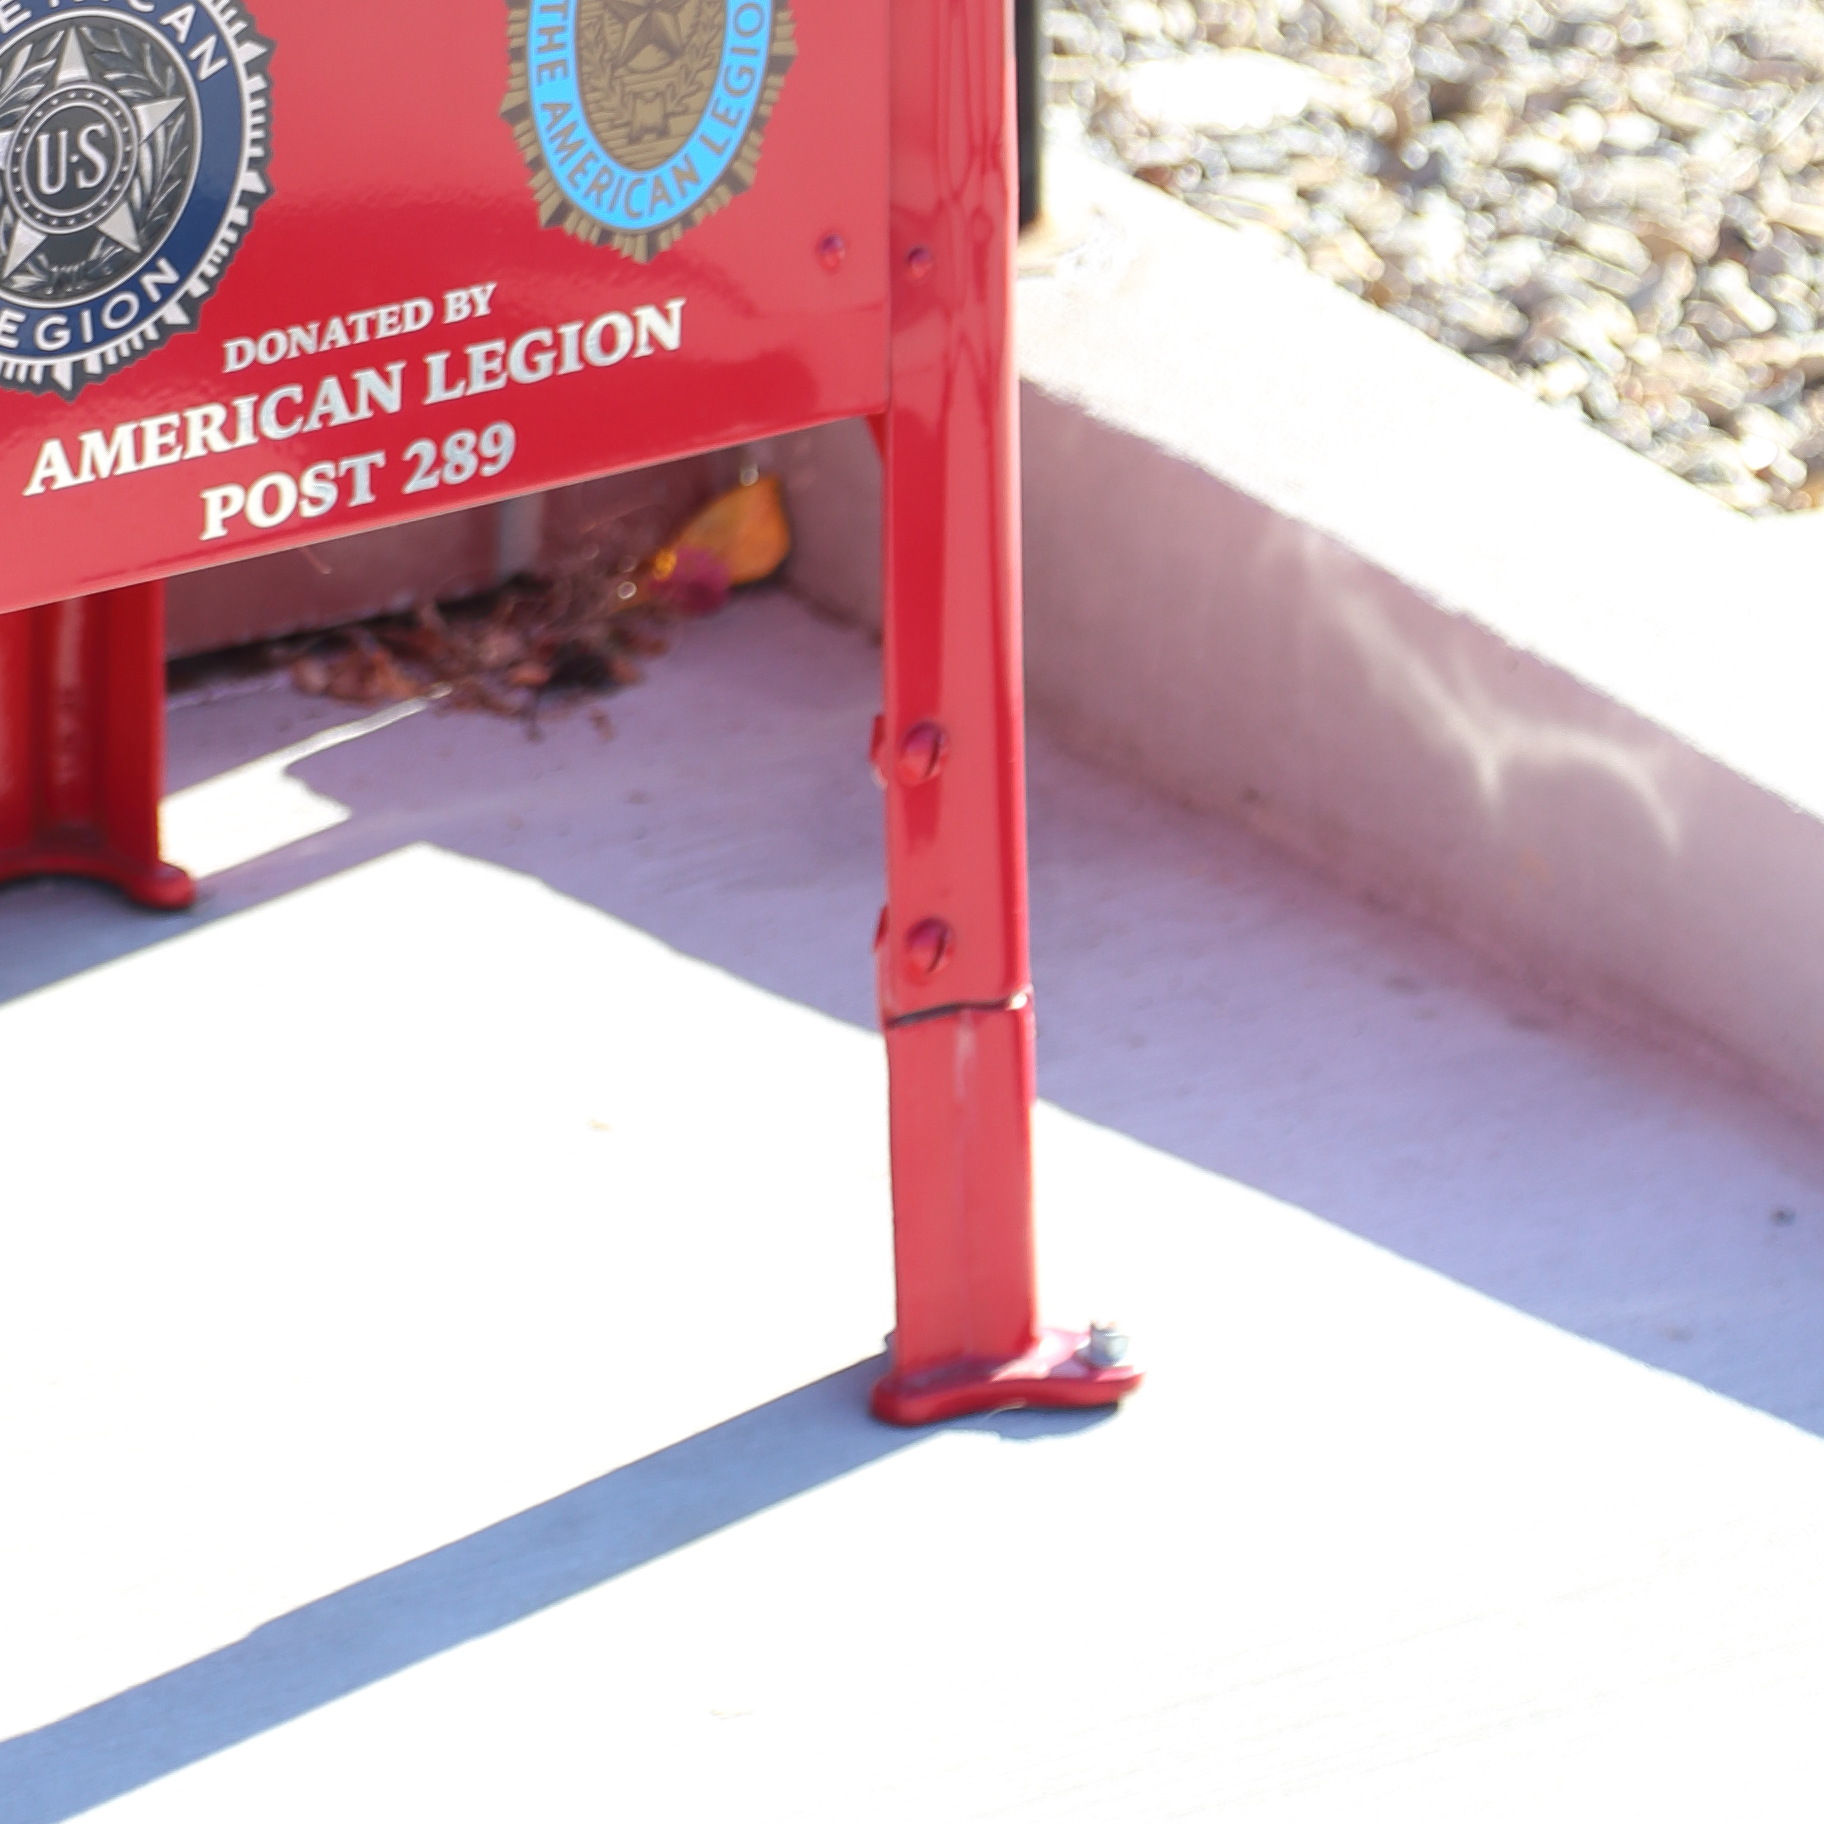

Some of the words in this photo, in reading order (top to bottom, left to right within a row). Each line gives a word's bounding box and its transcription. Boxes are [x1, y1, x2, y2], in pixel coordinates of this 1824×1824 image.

[540, 101, 703, 221] AMERICAN
[223, 297, 434, 374] DONATED
[443, 282, 498, 324] BY
[23, 362, 408, 497] AMERICAN
[422, 299, 688, 405] LEGION
[199, 451, 387, 541] POST
[403, 421, 516, 495] 289
